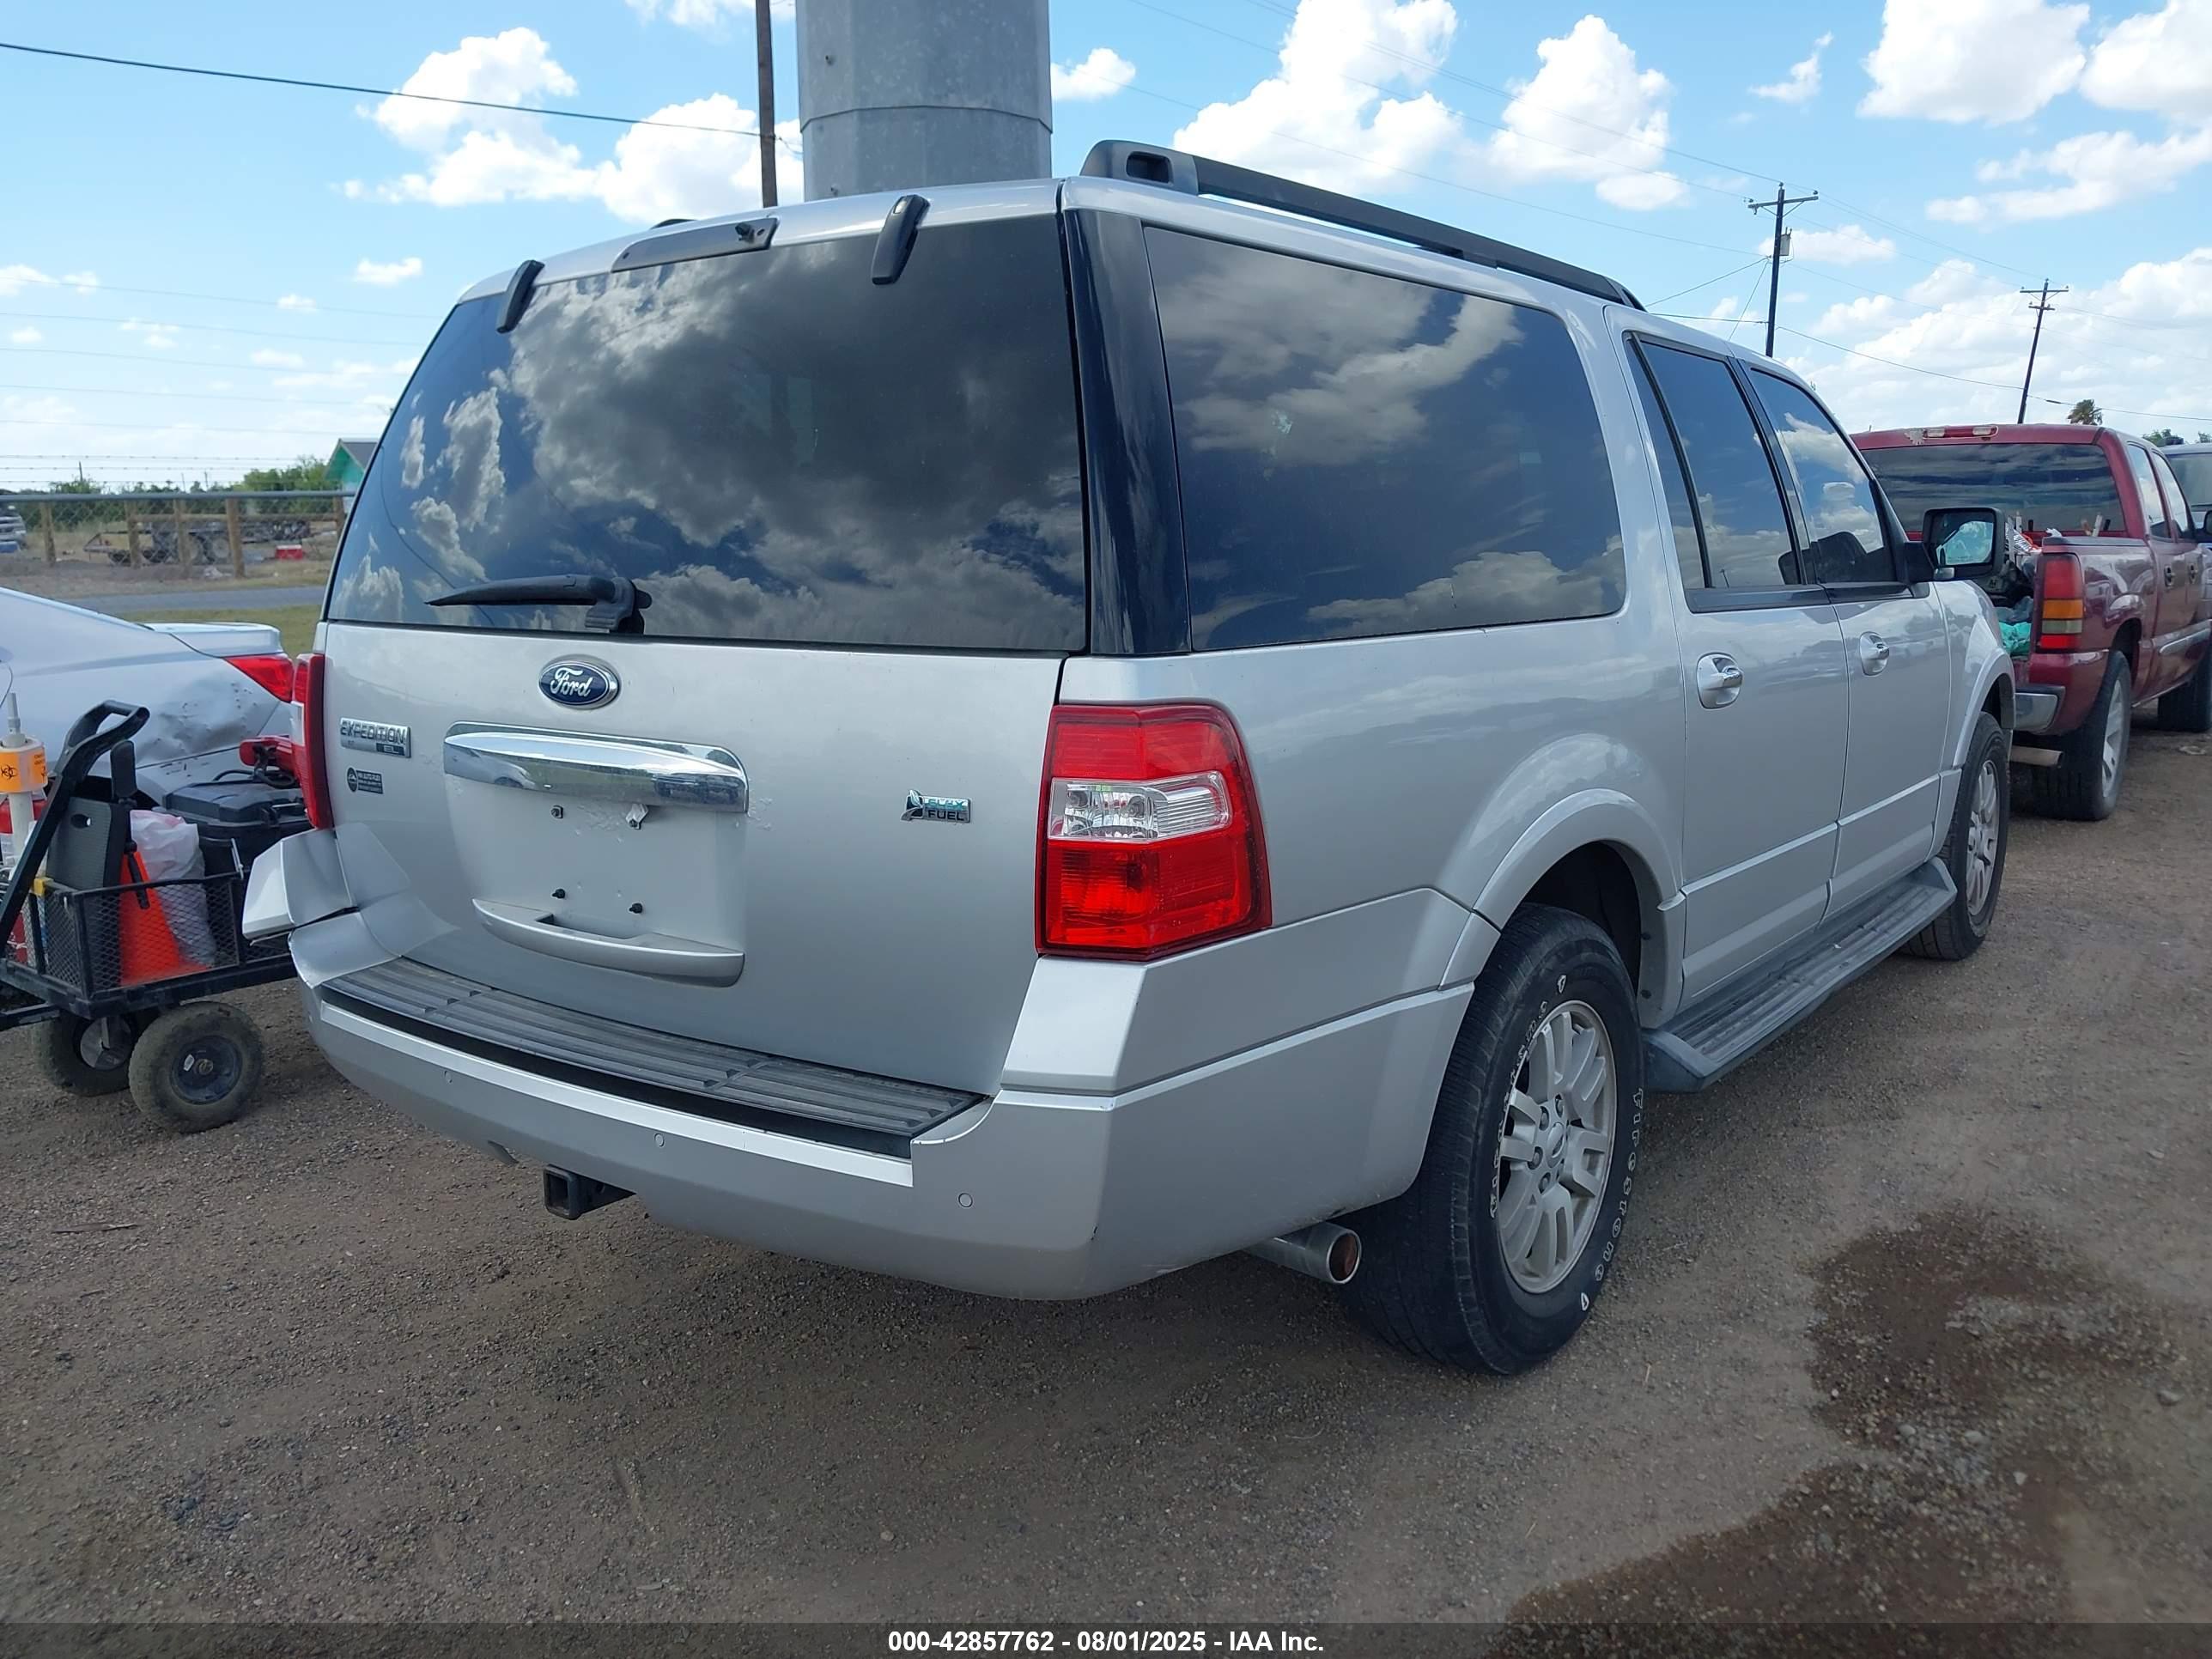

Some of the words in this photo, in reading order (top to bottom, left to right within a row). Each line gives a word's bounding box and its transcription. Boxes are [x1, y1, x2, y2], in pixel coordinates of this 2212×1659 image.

[550, 667, 593, 697] Ford
[340, 720, 407, 744] EXPEDITION
[383, 744, 399, 754] EL
[927, 810, 964, 821] FUEL
